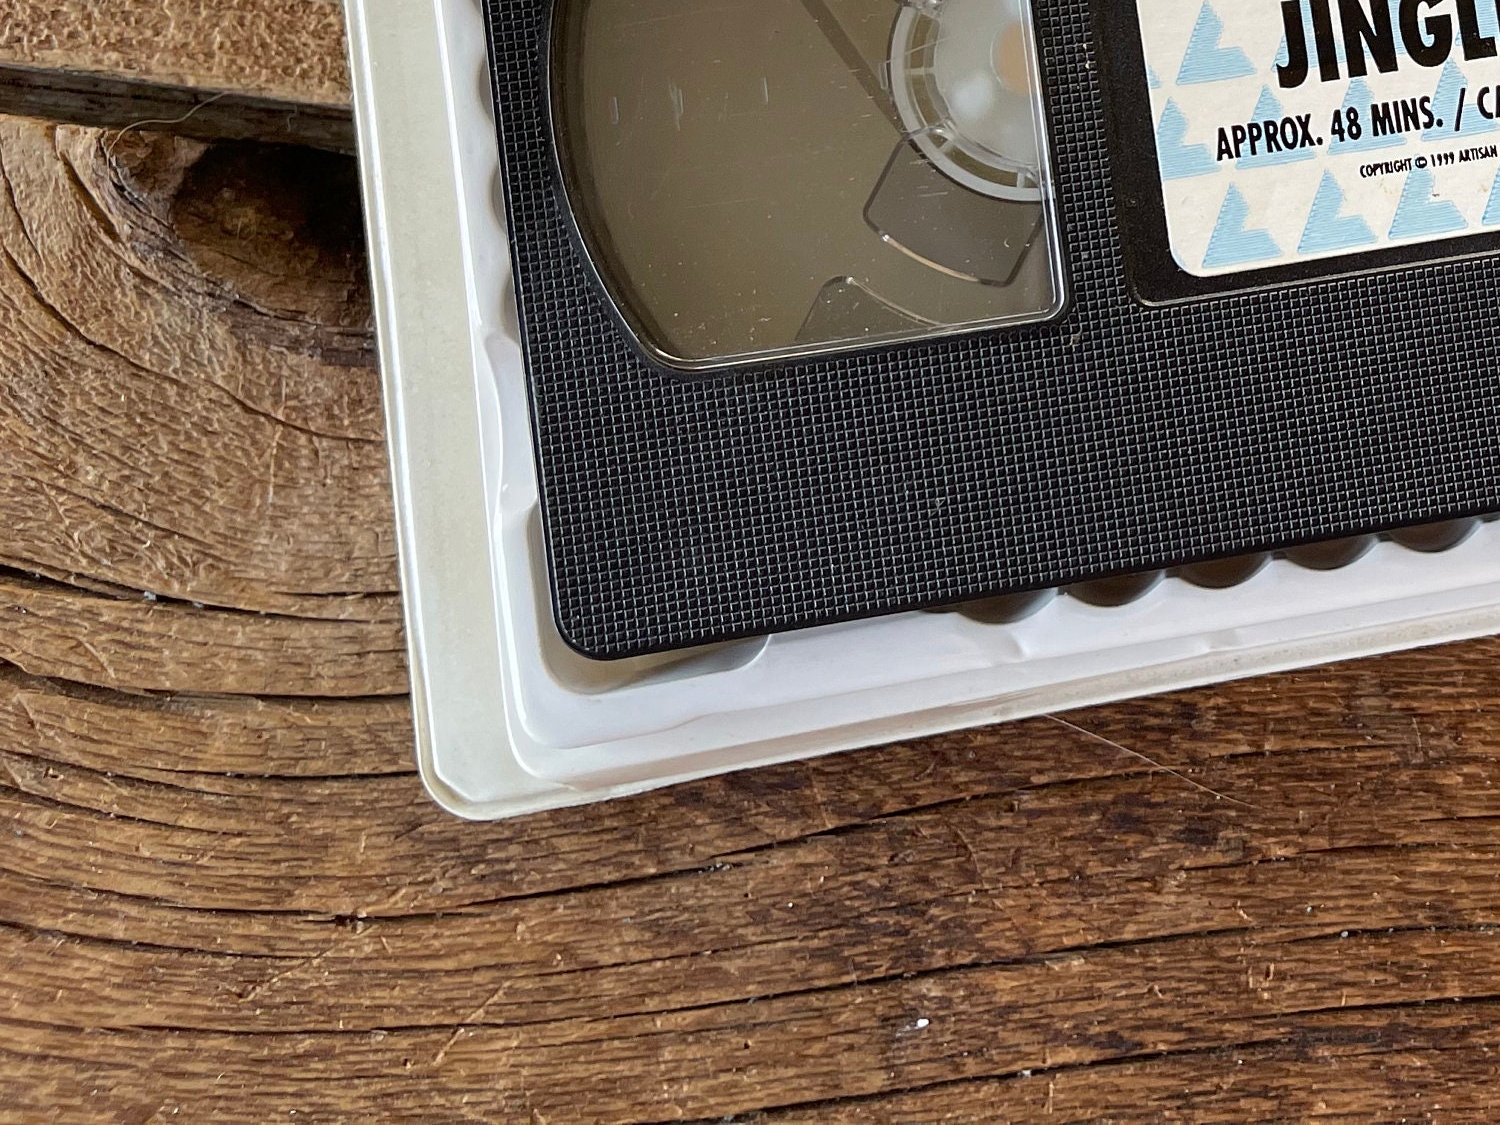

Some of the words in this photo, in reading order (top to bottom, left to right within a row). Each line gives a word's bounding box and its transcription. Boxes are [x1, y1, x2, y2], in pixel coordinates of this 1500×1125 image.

[1216, 112, 1323, 161] APPROX.
[1330, 106, 1362, 142] 48
[1370, 95, 1443, 137] MINS.
[1454, 87, 1466, 132] /
[1359, 158, 1413, 179] COPYRIGHT
[1430, 151, 1455, 168] 1999
[1458, 144, 1498, 164] ARTISAN
